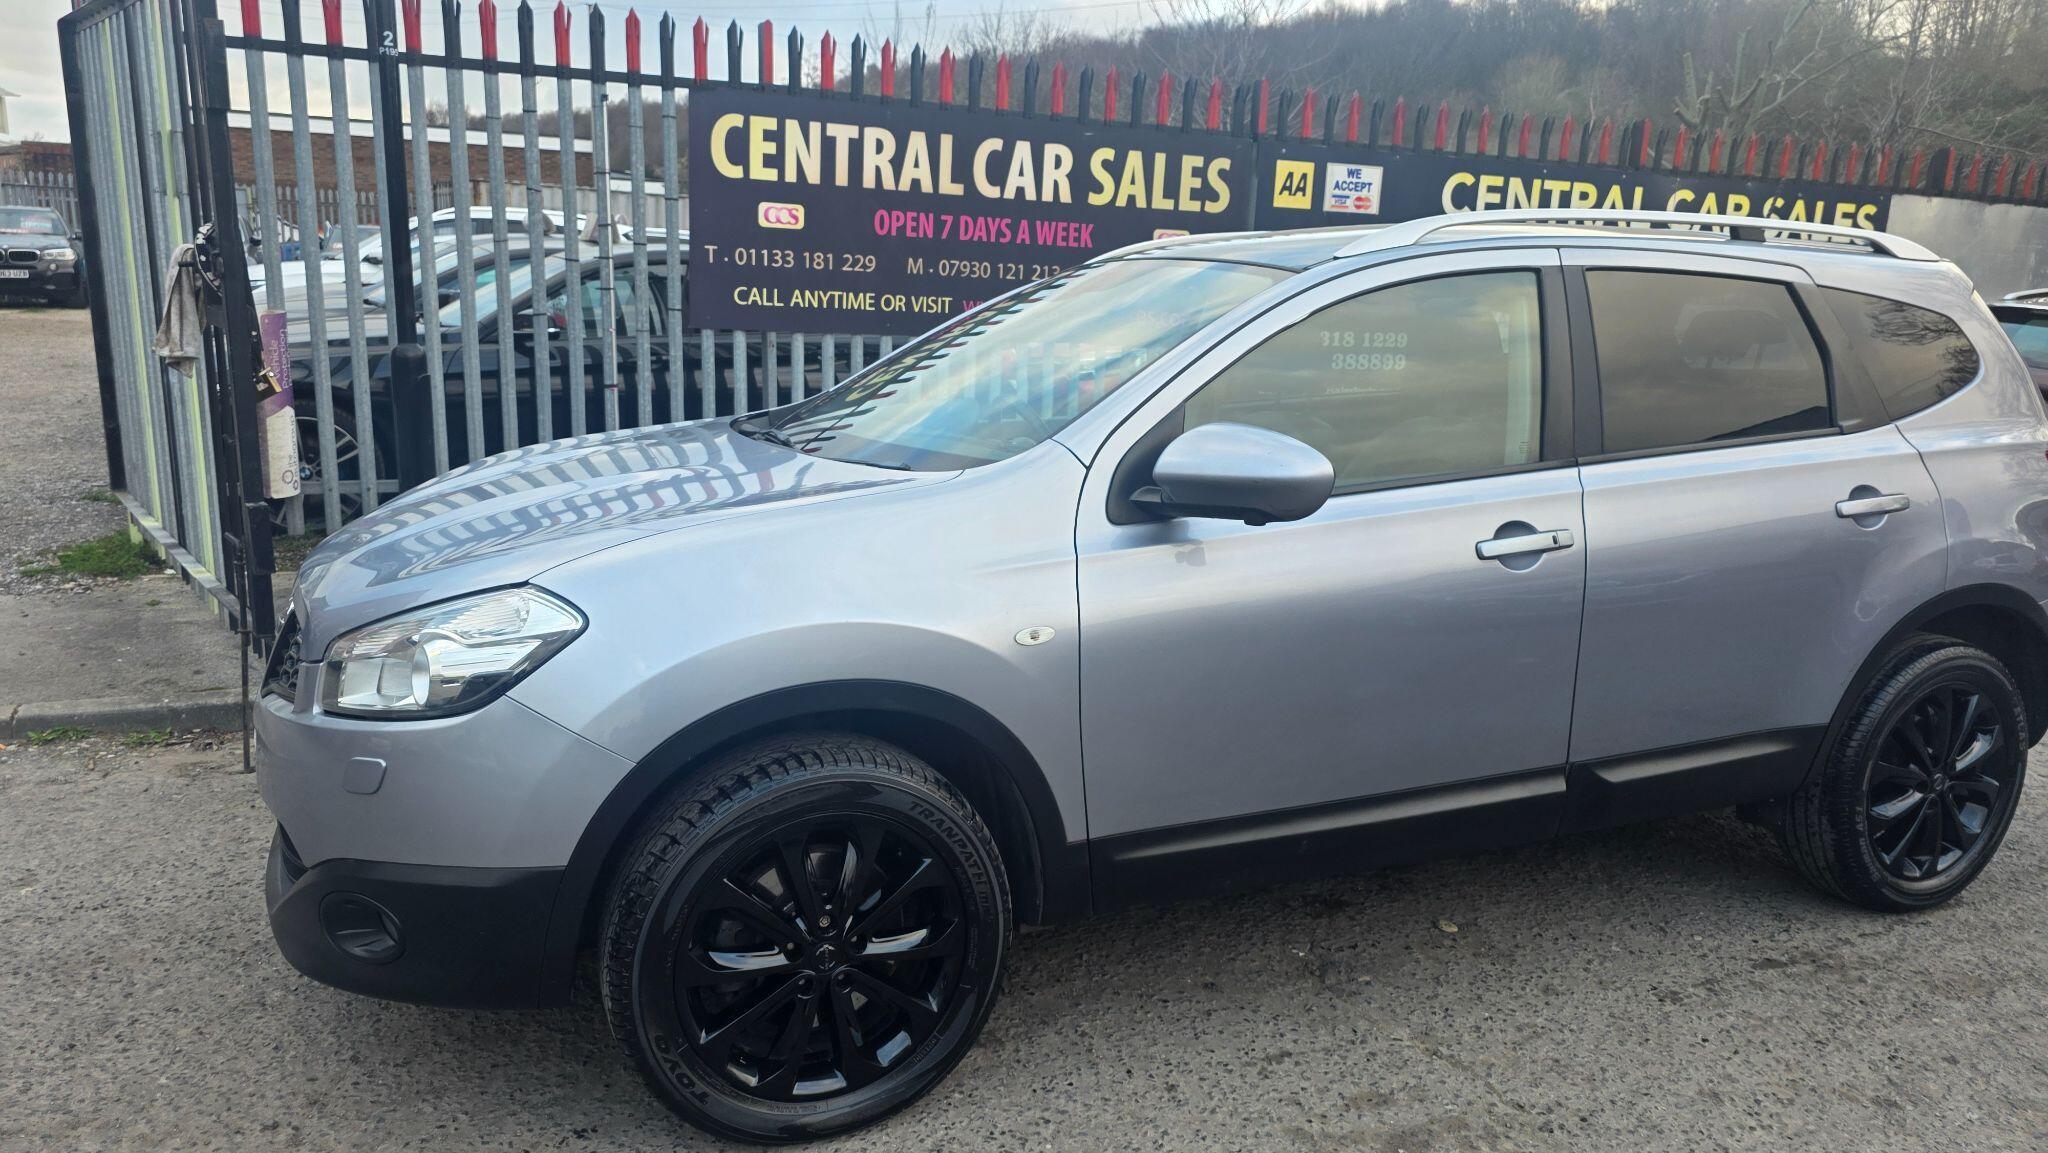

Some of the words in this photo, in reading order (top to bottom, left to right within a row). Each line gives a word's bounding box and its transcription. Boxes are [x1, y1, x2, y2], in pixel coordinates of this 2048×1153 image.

[383, 31, 394, 46] 2
[711, 113, 965, 196] CENTRAL
[973, 137, 1073, 204] CAR
[1087, 147, 1232, 214] SALES
[1347, 168, 1362, 179] WE
[1278, 171, 1308, 197] AA
[1333, 180, 1373, 193] ACCEPT
[873, 209, 934, 239] OPEN
[940, 214, 954, 240] 7
[959, 215, 1012, 244] DAYS
[1016, 219, 1031, 245] A
[1035, 221, 1095, 248] WEEK
[735, 247, 795, 268] 01133
[803, 252, 833, 271] 181
[842, 254, 877, 272] 229
[938, 260, 991, 279] 07930
[997, 263, 1024, 280] 121
[733, 287, 784, 307] CALL
[790, 289, 876, 311] ANYTIME
[880, 294, 906, 312] OR
[911, 295, 953, 314] VISIT
